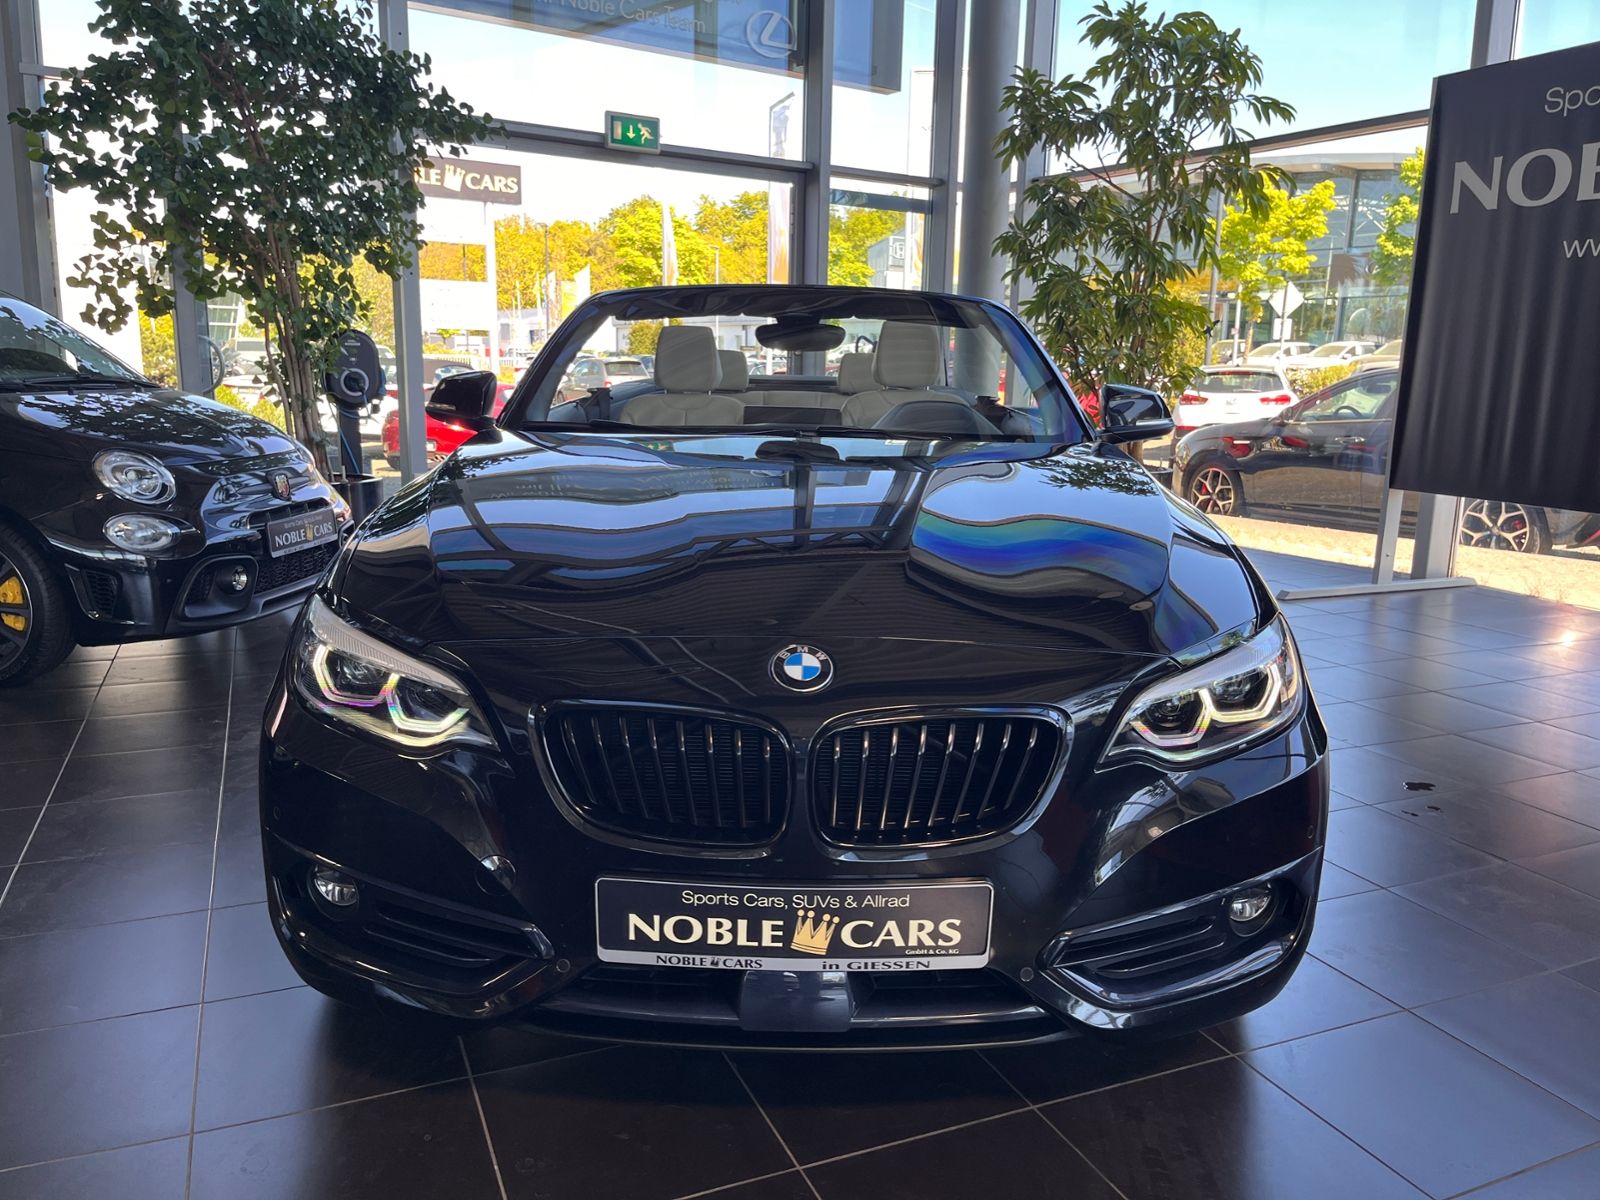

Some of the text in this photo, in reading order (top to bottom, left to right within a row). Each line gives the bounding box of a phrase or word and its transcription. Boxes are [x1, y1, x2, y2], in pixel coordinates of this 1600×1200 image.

[620, 0, 659, 24] Cars
[664, 6, 706, 32] Team
[465, 173, 519, 194] CARS
[275, 529, 306, 548] NOBLE
[313, 522, 333, 537] CARS
[779, 646, 828, 661] BMW
[682, 890, 910, 910] Sports Cars, SUVs & Allrad
[628, 913, 962, 949] NOBLE CARS
[656, 955, 763, 969] NOBLE CARS
[822, 961, 931, 970] in GIESSEN
